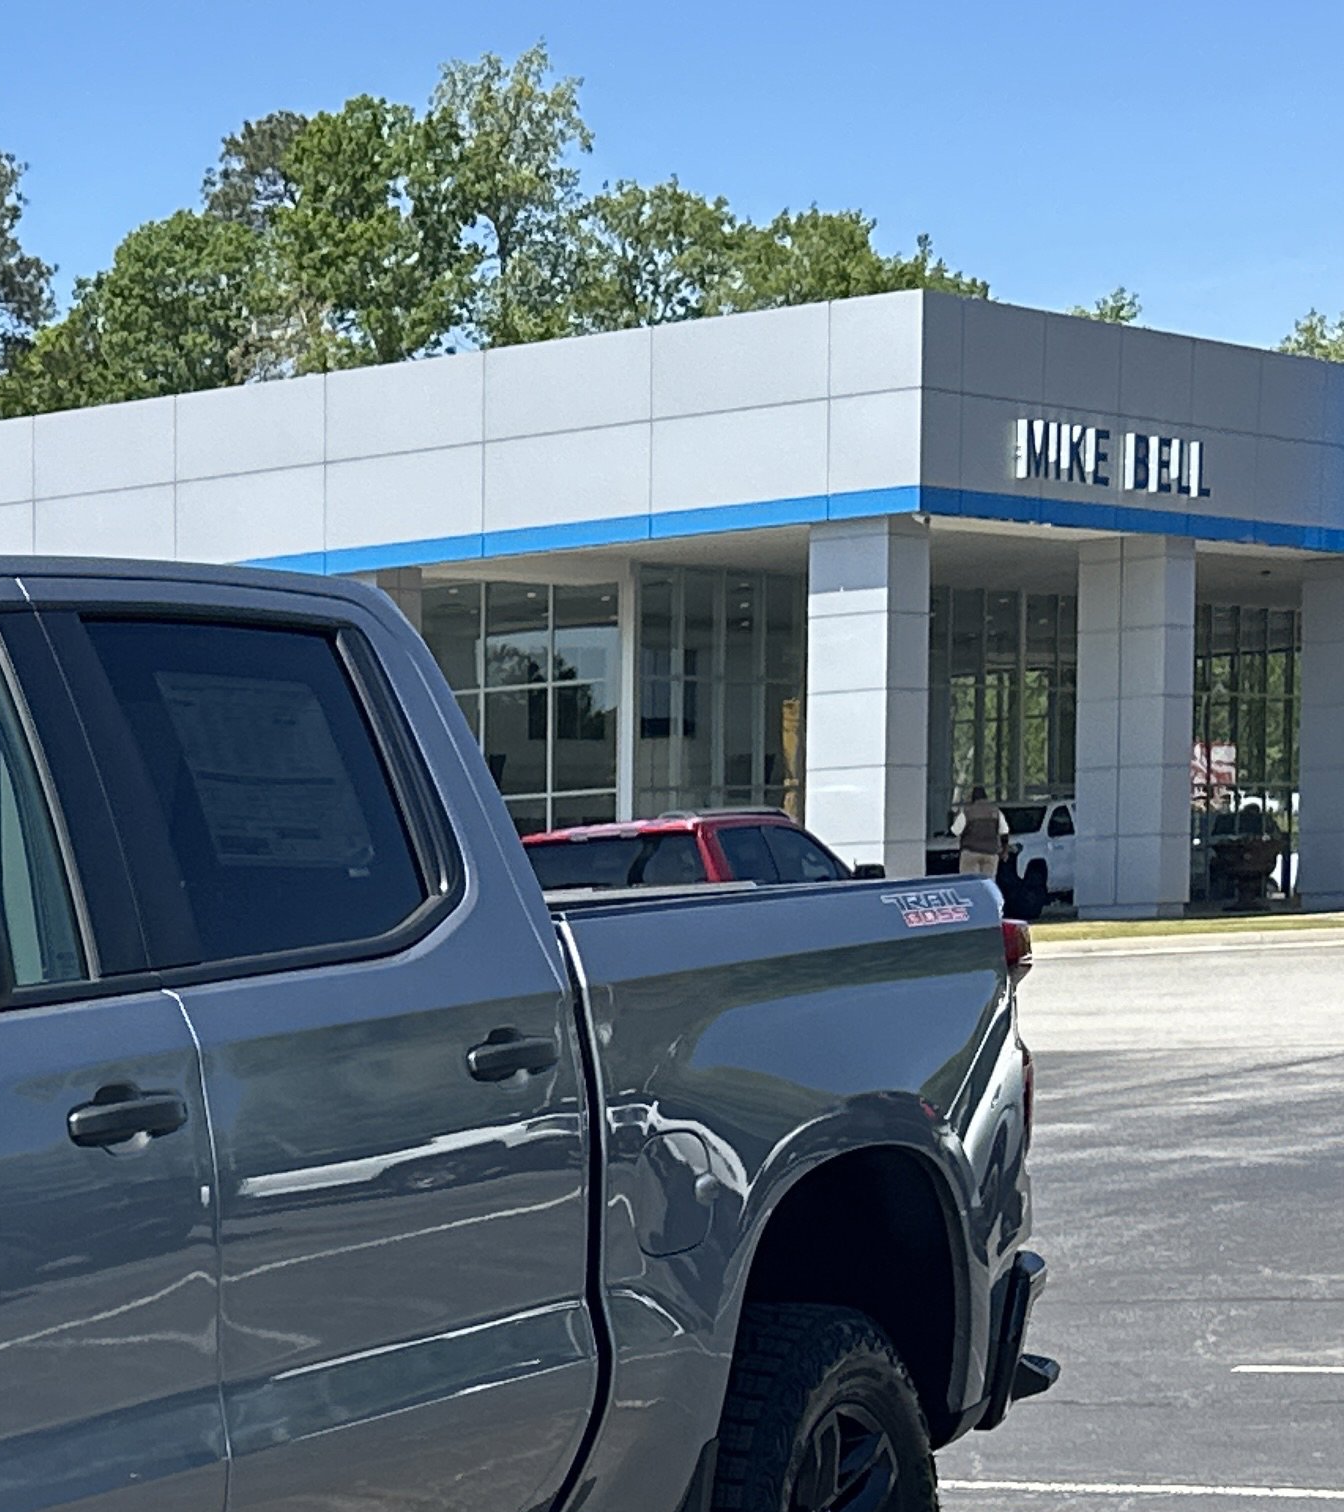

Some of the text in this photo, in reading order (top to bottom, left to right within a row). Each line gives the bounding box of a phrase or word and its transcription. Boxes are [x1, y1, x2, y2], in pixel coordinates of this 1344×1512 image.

[1016, 418, 1211, 498] MIKE BELL
[880, 888, 974, 912] TRAIL
[902, 906, 970, 928] BOSS
